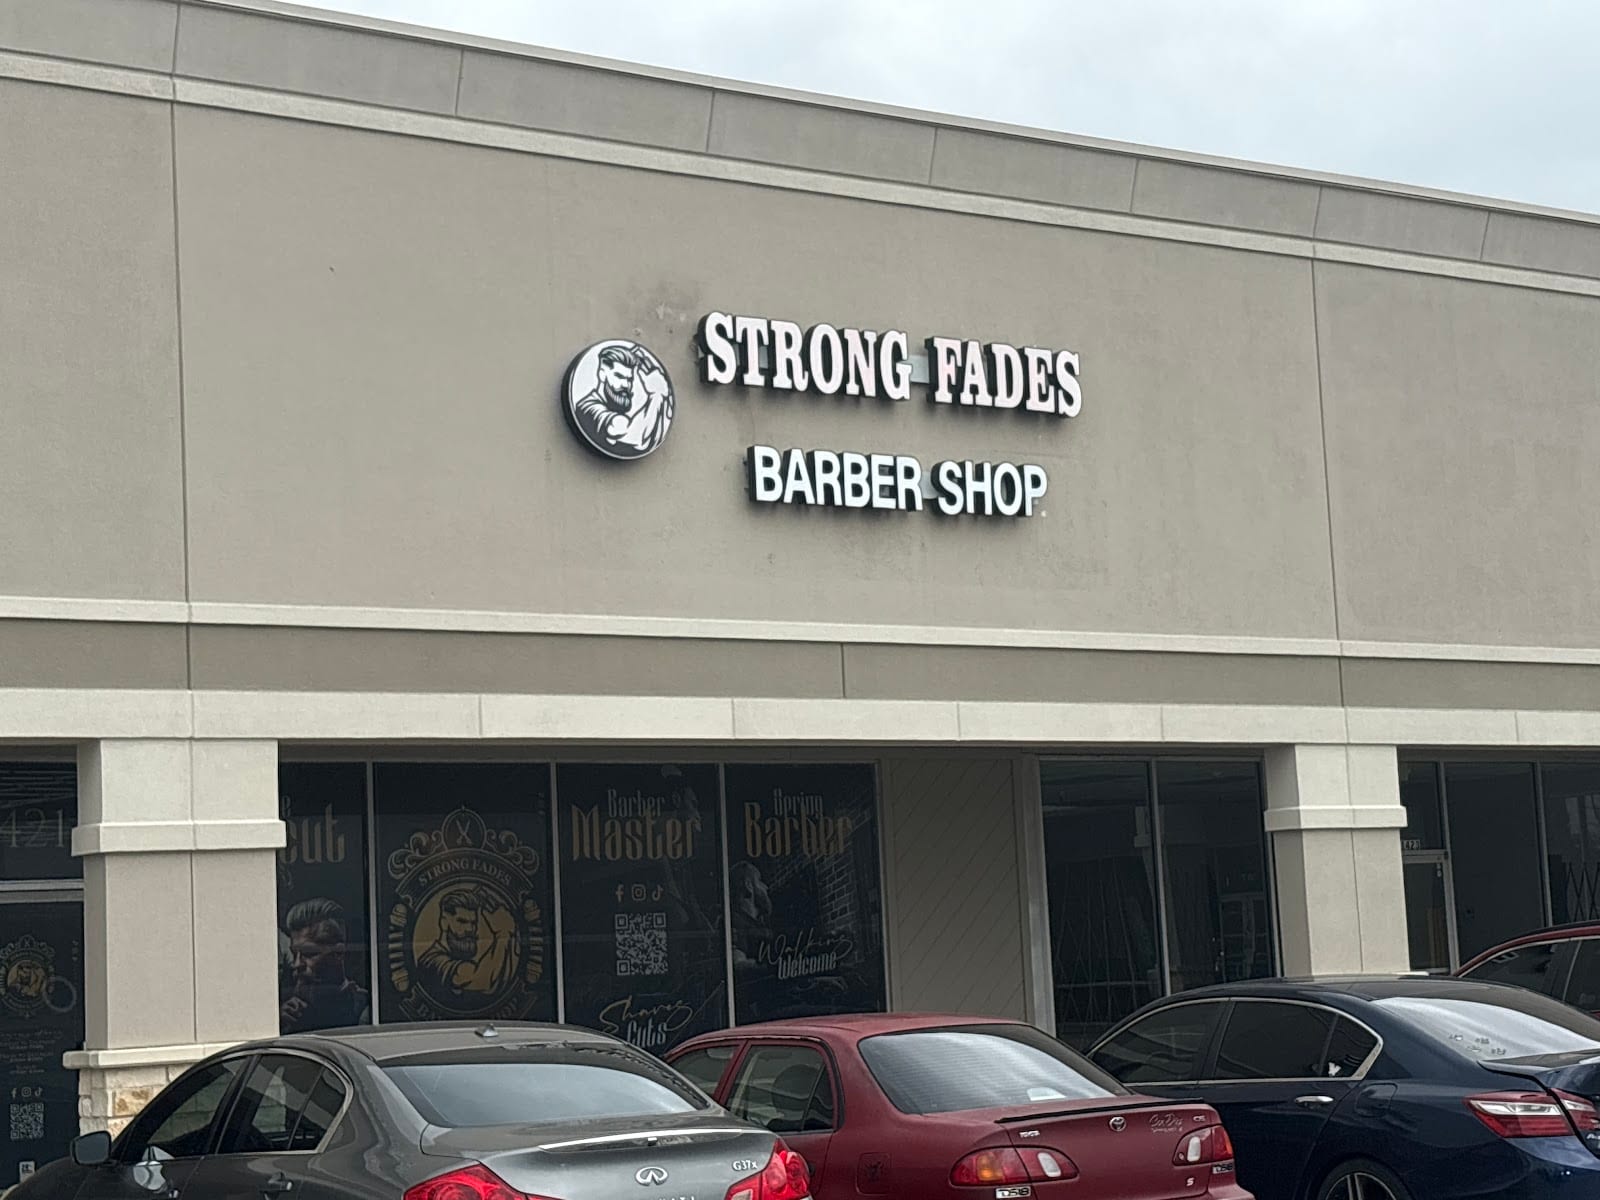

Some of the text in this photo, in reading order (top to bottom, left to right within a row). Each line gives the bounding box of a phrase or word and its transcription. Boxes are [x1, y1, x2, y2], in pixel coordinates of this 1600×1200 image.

[699, 311, 1082, 417] STRONG FADES
[750, 446, 1048, 517] BARBER SHOP
[607, 788, 665, 818] Barber
[571, 803, 701, 862] Master
[744, 801, 853, 858] Barber
[418, 857, 512, 887] STRONG FADES
[778, 951, 837, 980] Welcome
[627, 1017, 668, 1048] Cuts
[732, 1160, 758, 1171] G37x
